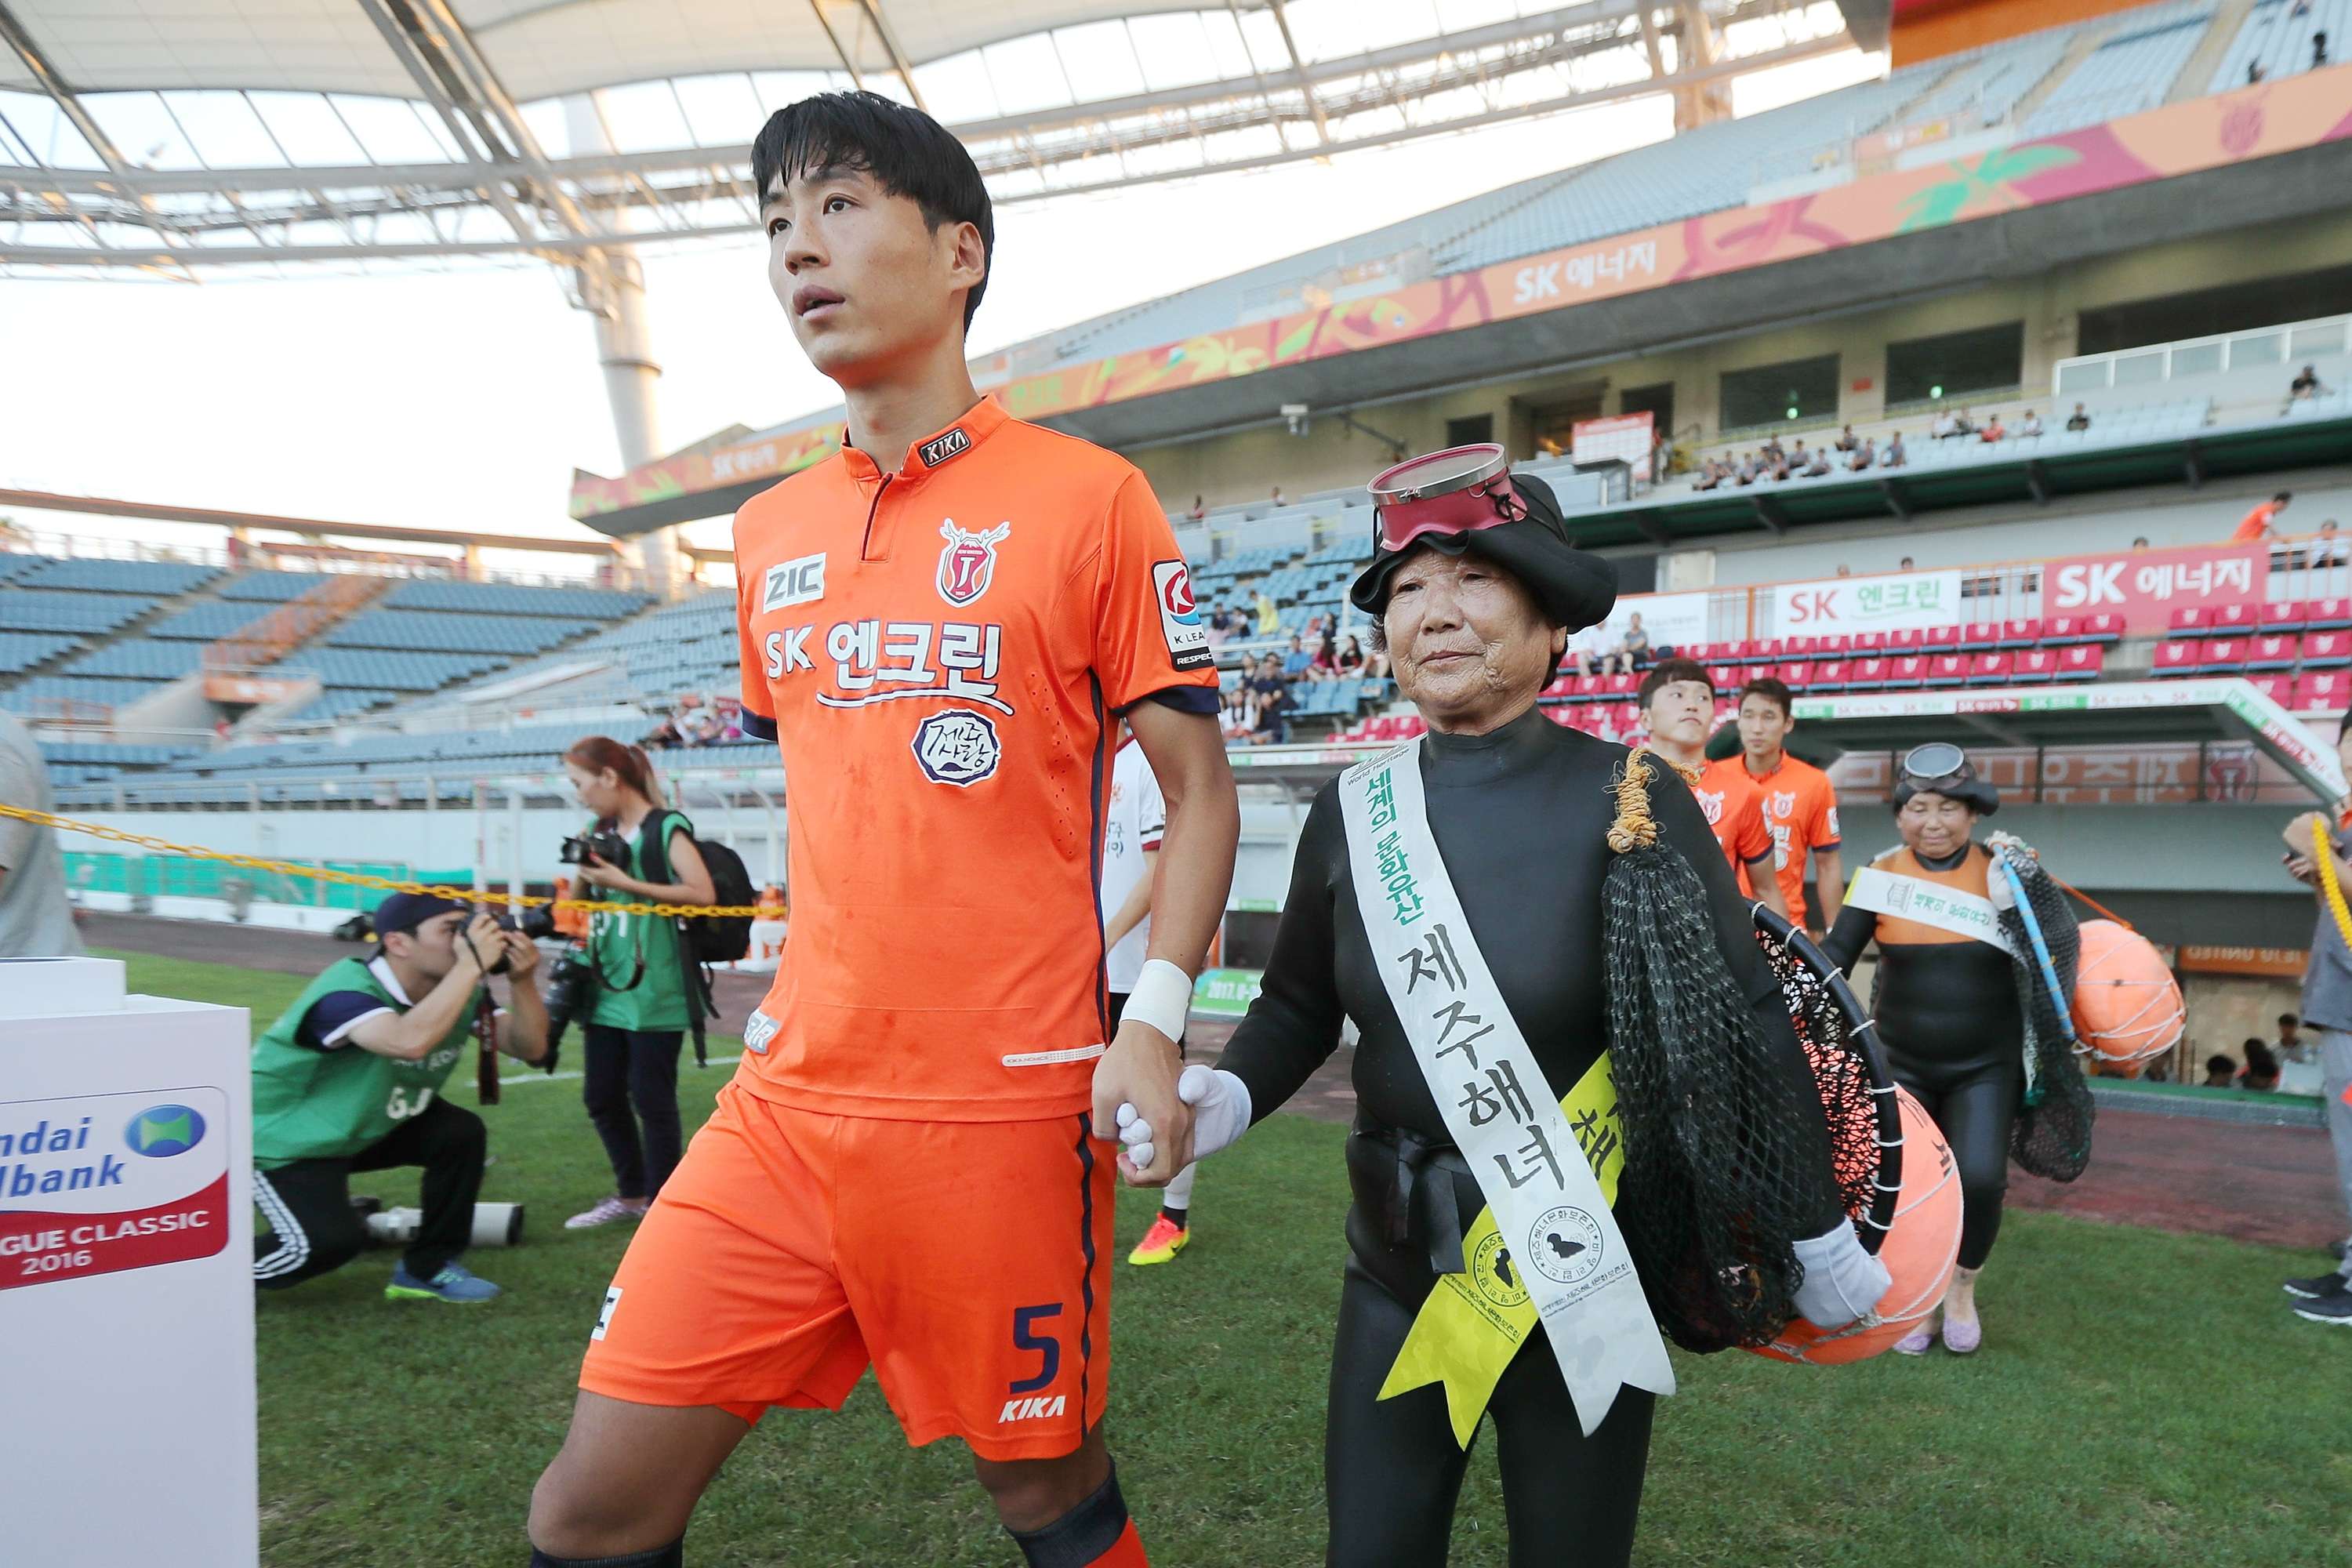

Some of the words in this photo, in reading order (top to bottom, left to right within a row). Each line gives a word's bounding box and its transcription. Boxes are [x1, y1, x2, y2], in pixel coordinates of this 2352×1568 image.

[1515, 262, 1561, 304] SK
[1566, 241, 1657, 289] 에너지
[927, 431, 967, 463] KIKA
[1789, 590, 1839, 622] SK
[1857, 579, 1941, 612] 엔크린
[2055, 561, 2127, 608] SK
[2136, 557, 2252, 601] 에너지
[765, 626, 815, 679] SK
[826, 619, 1002, 698] 엔크린
[1347, 768, 1370, 786] World
[1365, 767, 1397, 833] 세계의
[1374, 829, 1424, 926] 문화유산
[1398, 924, 1564, 1190] 제주해녀
[71, 1210, 210, 1245] CLASSIC
[21, 1250, 93, 1276] 2016
[1009, 1301, 1063, 1393] 5
[998, 1395, 1066, 1424] KIKA
